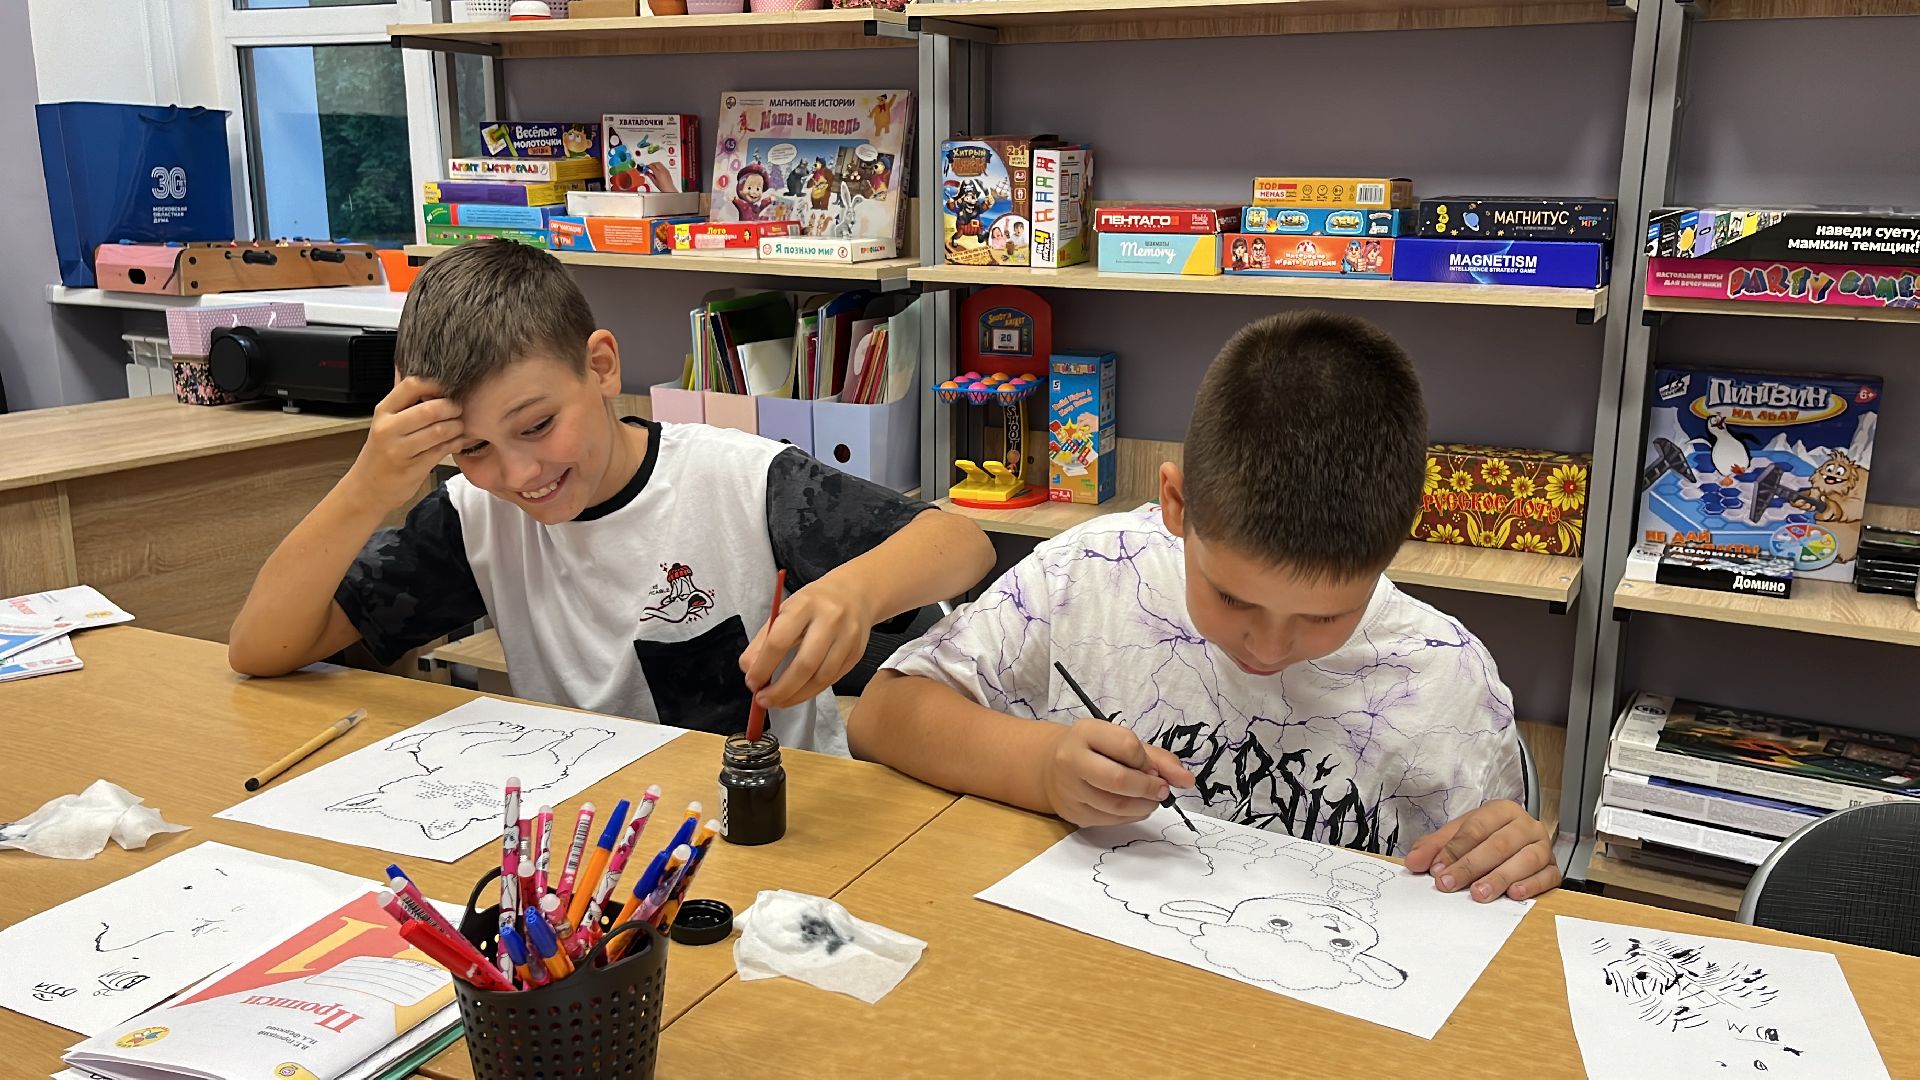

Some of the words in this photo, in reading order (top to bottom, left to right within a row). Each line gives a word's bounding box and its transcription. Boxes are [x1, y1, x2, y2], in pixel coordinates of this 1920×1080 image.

[769, 98, 817, 107] МАГНИТНЫЕ
[818, 98, 855, 107] ИСТОРИИ
[760, 110, 794, 131] Маша
[805, 112, 861, 136] Медведь
[1259, 182, 1278, 190] TOP
[1101, 215, 1171, 226] ПЕНТАГО
[1494, 210, 1570, 225] МАГНИТУС
[1581, 219, 1598, 227] ИГР
[1816, 225, 1872, 239] наведи
[1875, 227, 1920, 240] суету,
[1120, 241, 1176, 264] Memory
[1788, 238, 1849, 251] мамкин
[1852, 241, 1920, 255] темщик!
[1450, 253, 1537, 268] MAGNETISM
[1727, 264, 1836, 304] PARTY
[1000, 333, 1012, 342] 20
[1708, 377, 1828, 408] ПИНГВИН
[1859, 390, 1875, 400] 6+
[1731, 408, 1754, 421] НА
[1757, 410, 1800, 422] ЛЬДУ
[1007, 405, 1020, 451] SHOOT
[1510, 497, 1561, 525] ЛОТО
[1732, 575, 1786, 592] Домино
[240, 995, 365, 1034] Прописи
